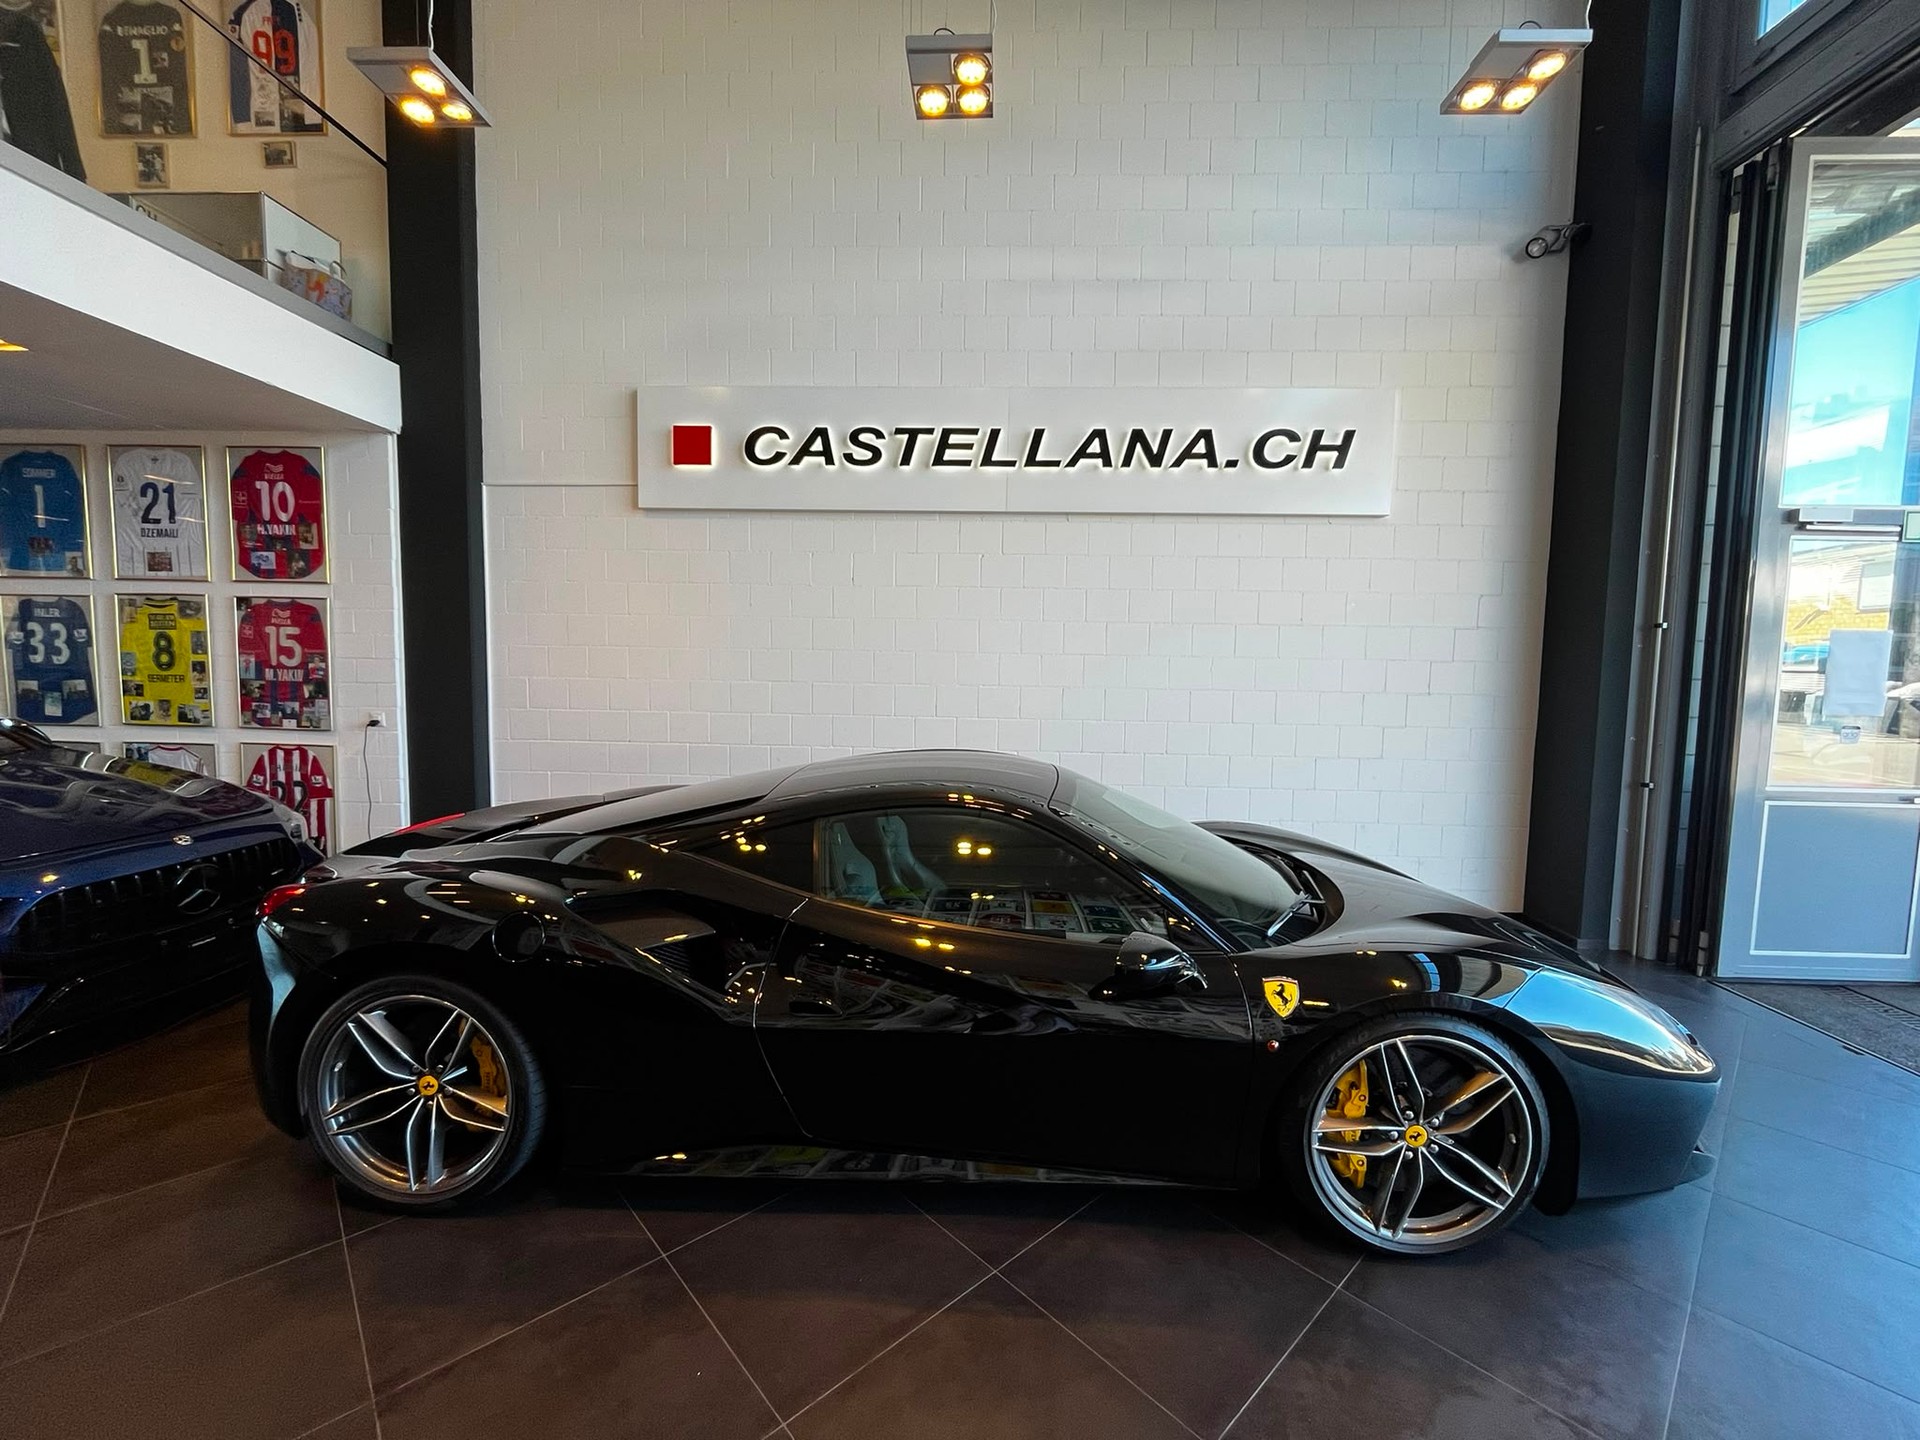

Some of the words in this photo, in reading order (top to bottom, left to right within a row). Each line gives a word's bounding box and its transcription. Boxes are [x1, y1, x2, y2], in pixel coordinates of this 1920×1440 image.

[131, 40, 157, 84] 1
[252, 28, 297, 76] 99
[744, 425, 1357, 470] CASTELLANA.CH
[34, 485, 46, 528] 1
[140, 482, 177, 524] 21
[255, 480, 295, 522] 10
[33, 607, 60, 618] INLER
[27, 622, 70, 664] 33
[152, 631, 176, 671] 8
[265, 626, 303, 667] 15
